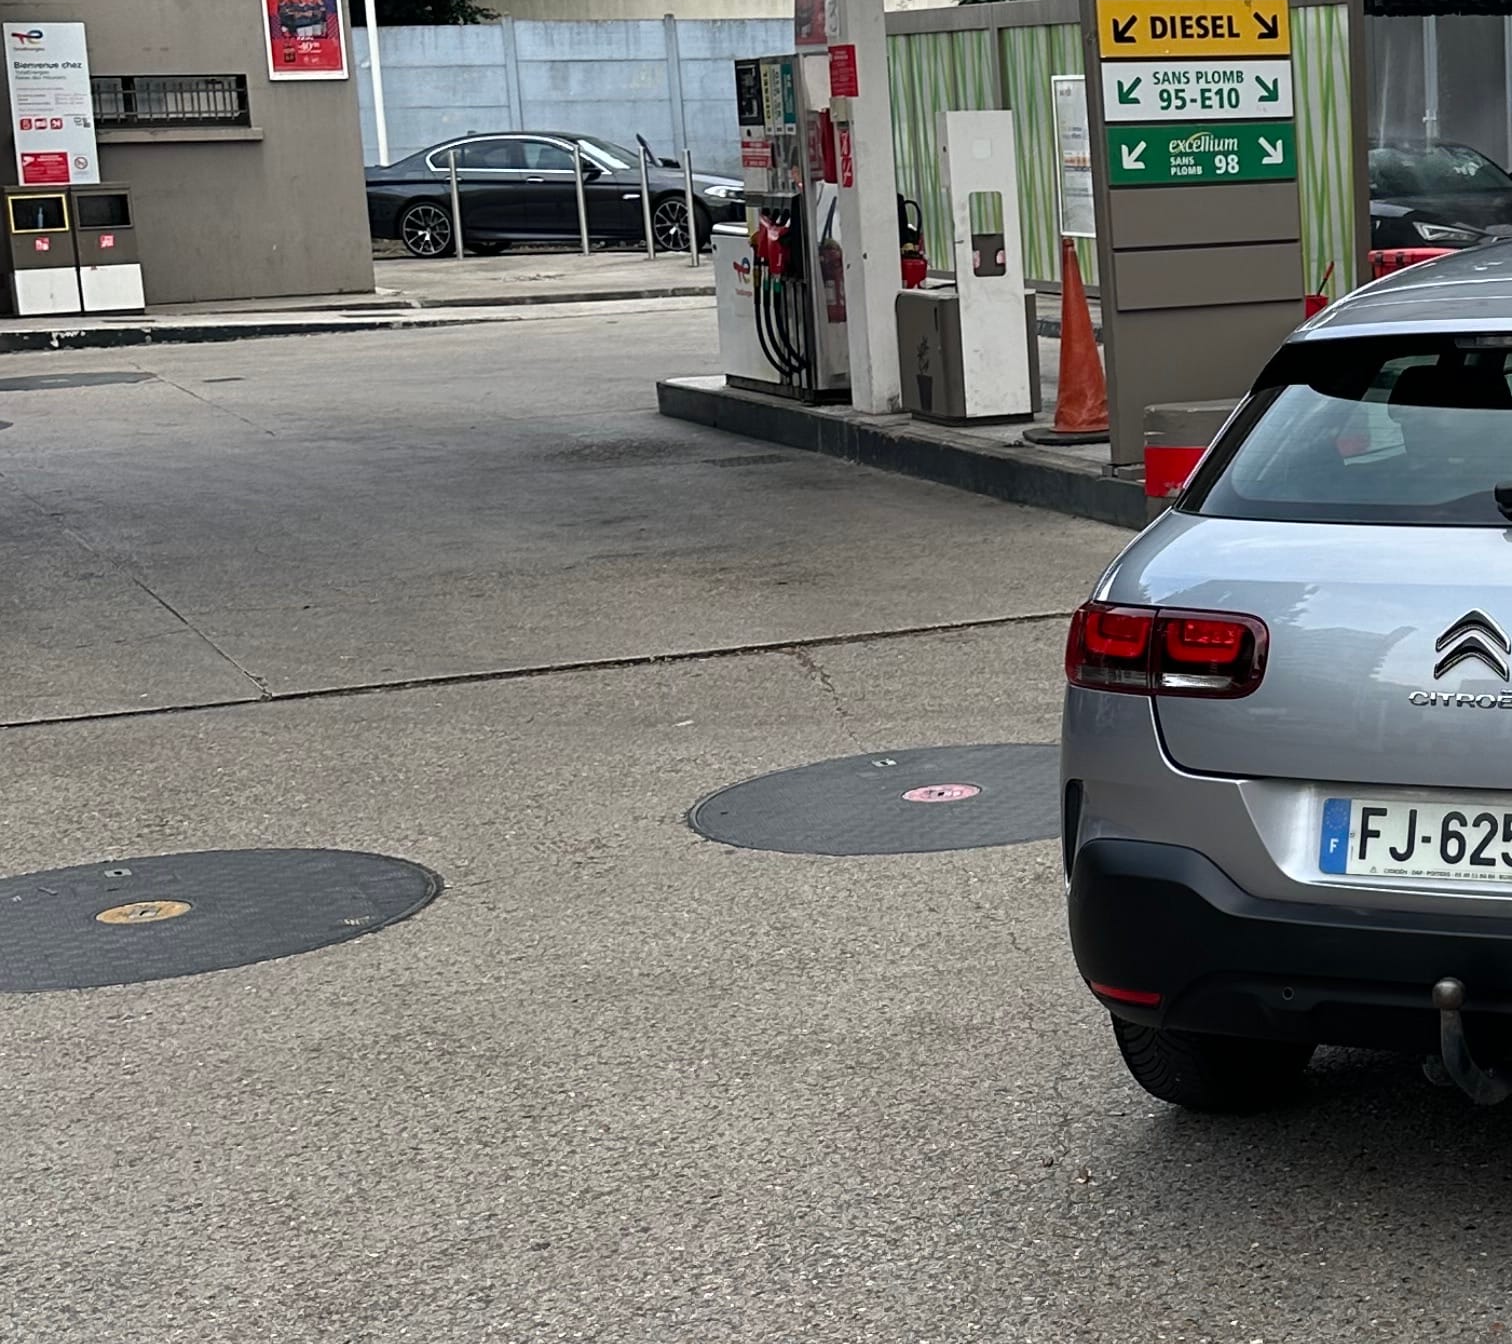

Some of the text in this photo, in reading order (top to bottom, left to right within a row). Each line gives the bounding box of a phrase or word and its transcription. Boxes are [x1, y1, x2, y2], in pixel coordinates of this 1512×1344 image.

[1149, 15, 1241, 40] DIESEL
[1152, 69, 1245, 86] SANS PLOMB
[1158, 87, 1241, 111] 95-E10
[1168, 134, 1239, 154] excellium
[1169, 156, 1195, 166] SANS
[1214, 154, 1240, 175] 98
[1170, 166, 1203, 176] PLOMB
[1328, 837, 1340, 854] F
